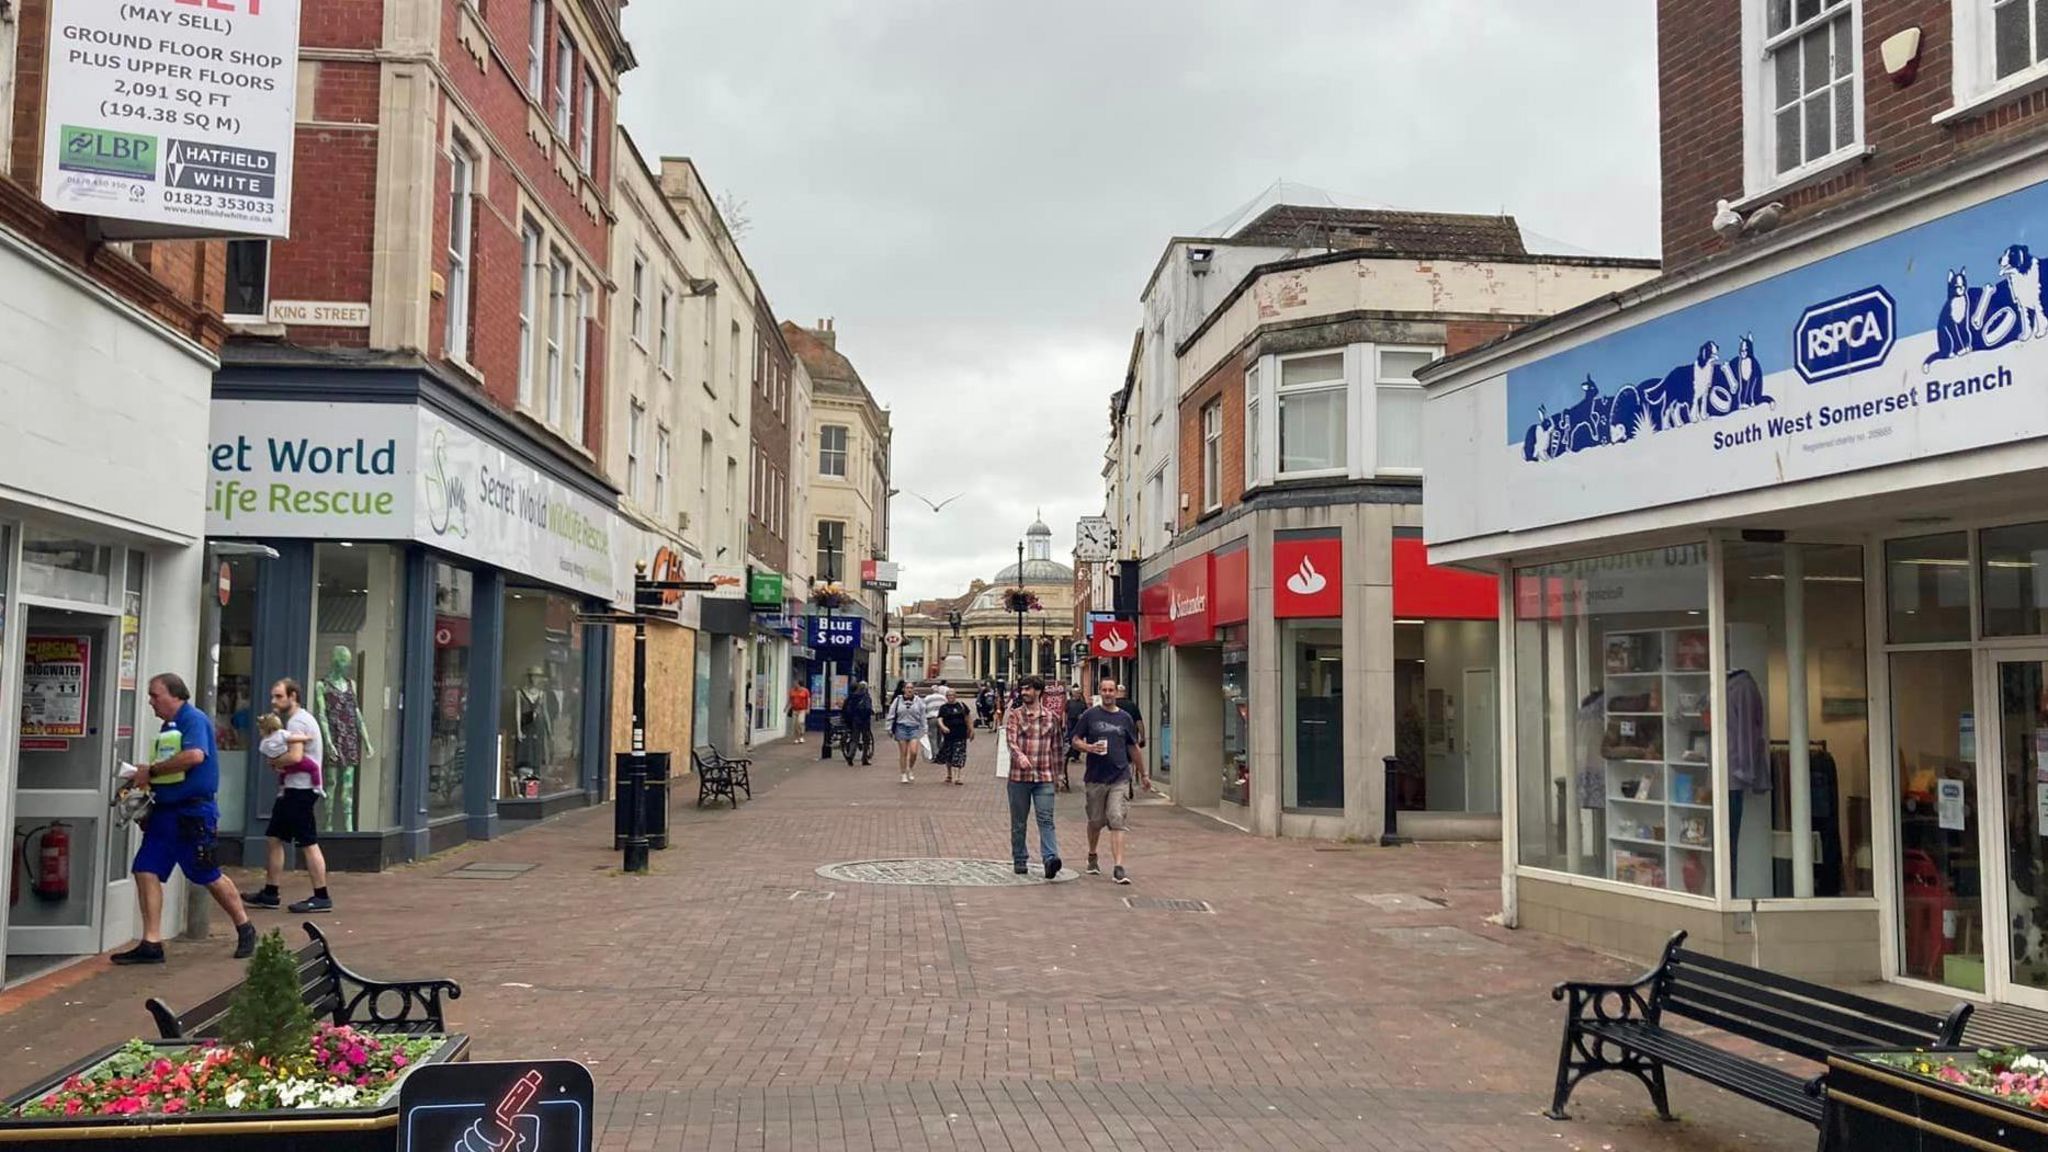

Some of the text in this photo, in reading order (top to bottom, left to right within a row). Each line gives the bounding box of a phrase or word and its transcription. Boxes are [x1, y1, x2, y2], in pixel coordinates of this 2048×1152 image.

[120, 3, 172, 24] (MAY
[178, 13, 233, 36] SELL)
[63, 25, 283, 70] GROUND FLOOR SHOP
[69, 50, 275, 91] PLUS UPPER FLOORS
[114, 79, 231, 108] 2,091 SQ FT
[100, 100, 240, 134] (194.38 SQ M)
[96, 134, 149, 161] LBP
[186, 147, 270, 169] HATFIELD
[194, 172, 262, 193] WHITE
[163, 190, 213, 207] 01823
[217, 199, 274, 214] 353033
[274, 305, 367, 321] KING STREET
[1807, 311, 1883, 360] RSPCA
[1713, 365, 2013, 450] South West Somerset Branch
[208, 435, 396, 475] et World
[205, 480, 393, 520] ife Rescue
[480, 465, 515, 515] Secret
[518, 484, 547, 529] World
[1177, 585, 1206, 618] Santander
[819, 617, 853, 631] BLUE
